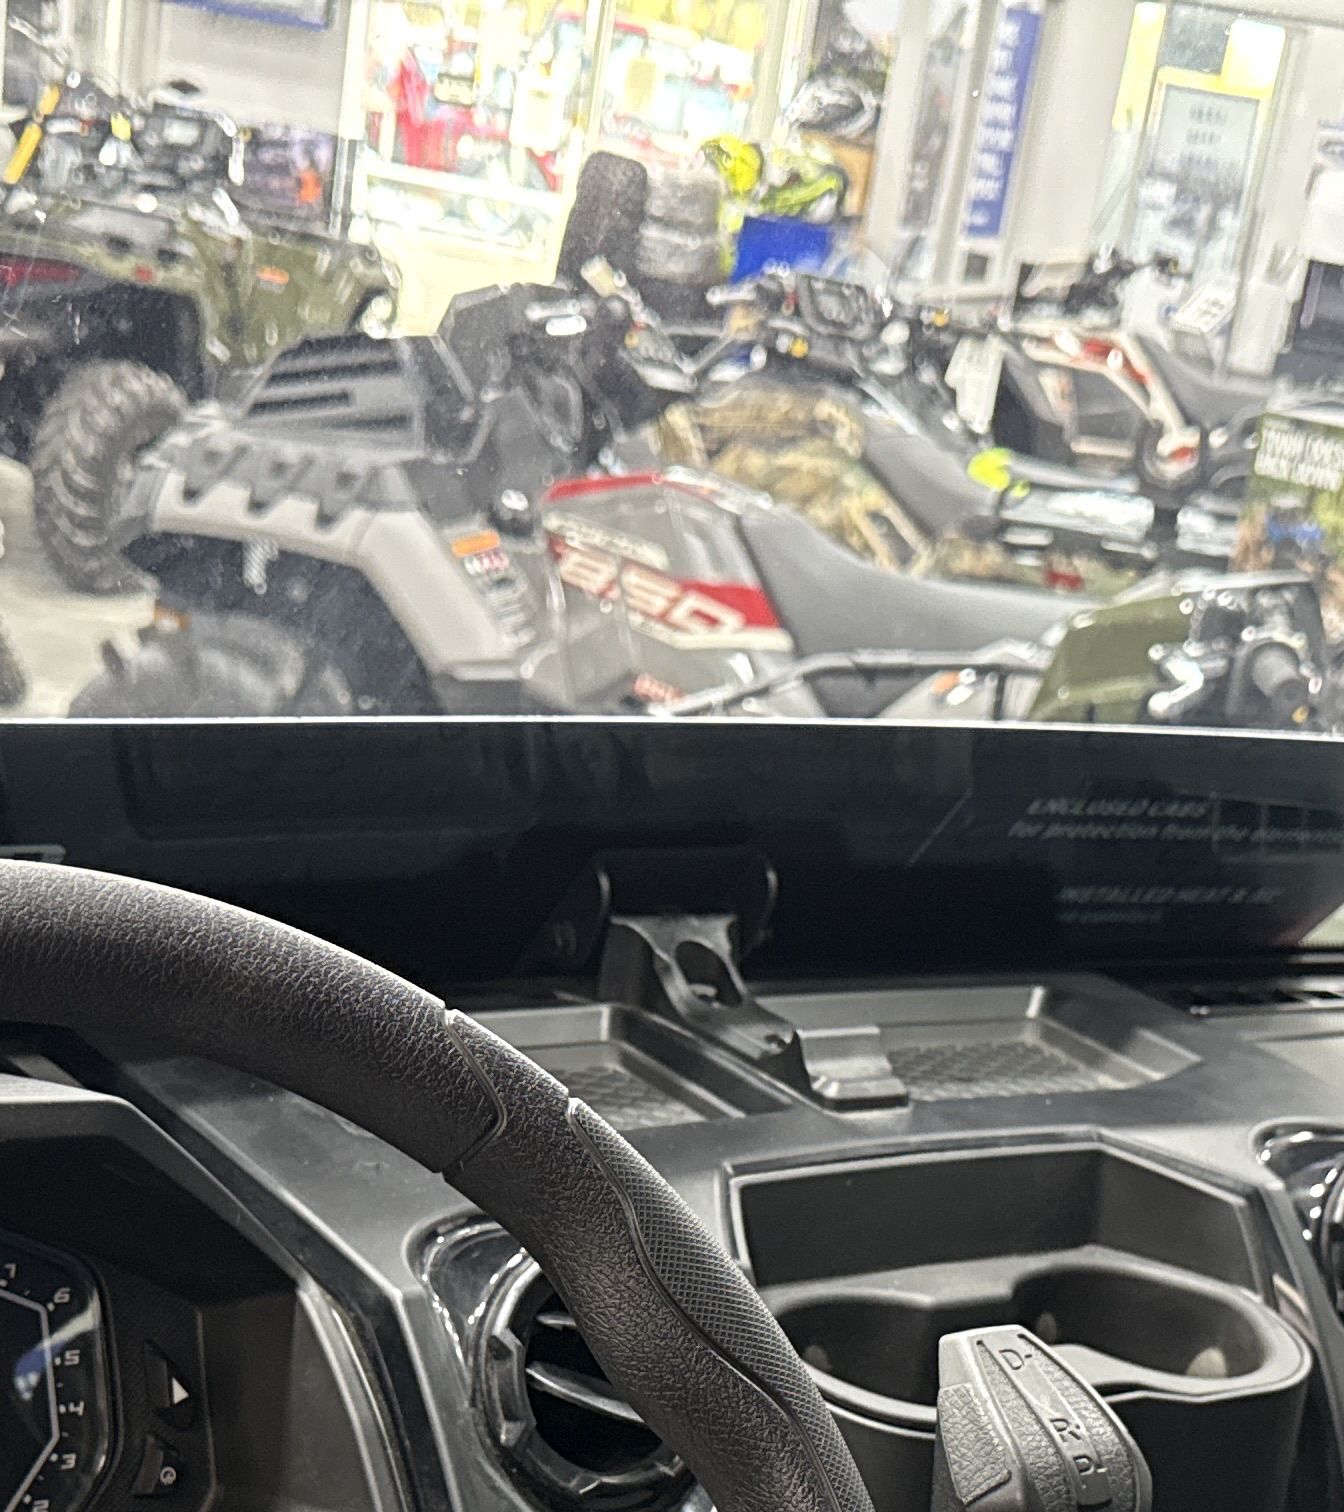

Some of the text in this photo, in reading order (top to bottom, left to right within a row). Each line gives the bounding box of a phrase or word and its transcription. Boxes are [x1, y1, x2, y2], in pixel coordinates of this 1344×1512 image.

[4, 1263, 17, 1279] 7
[53, 1287, 71, 1303] 6
[64, 1350, 81, 1366] 5
[69, 1401, 85, 1416] 4
[1050, 1418, 1082, 1443] R
[60, 1453, 77, 1471] 3
